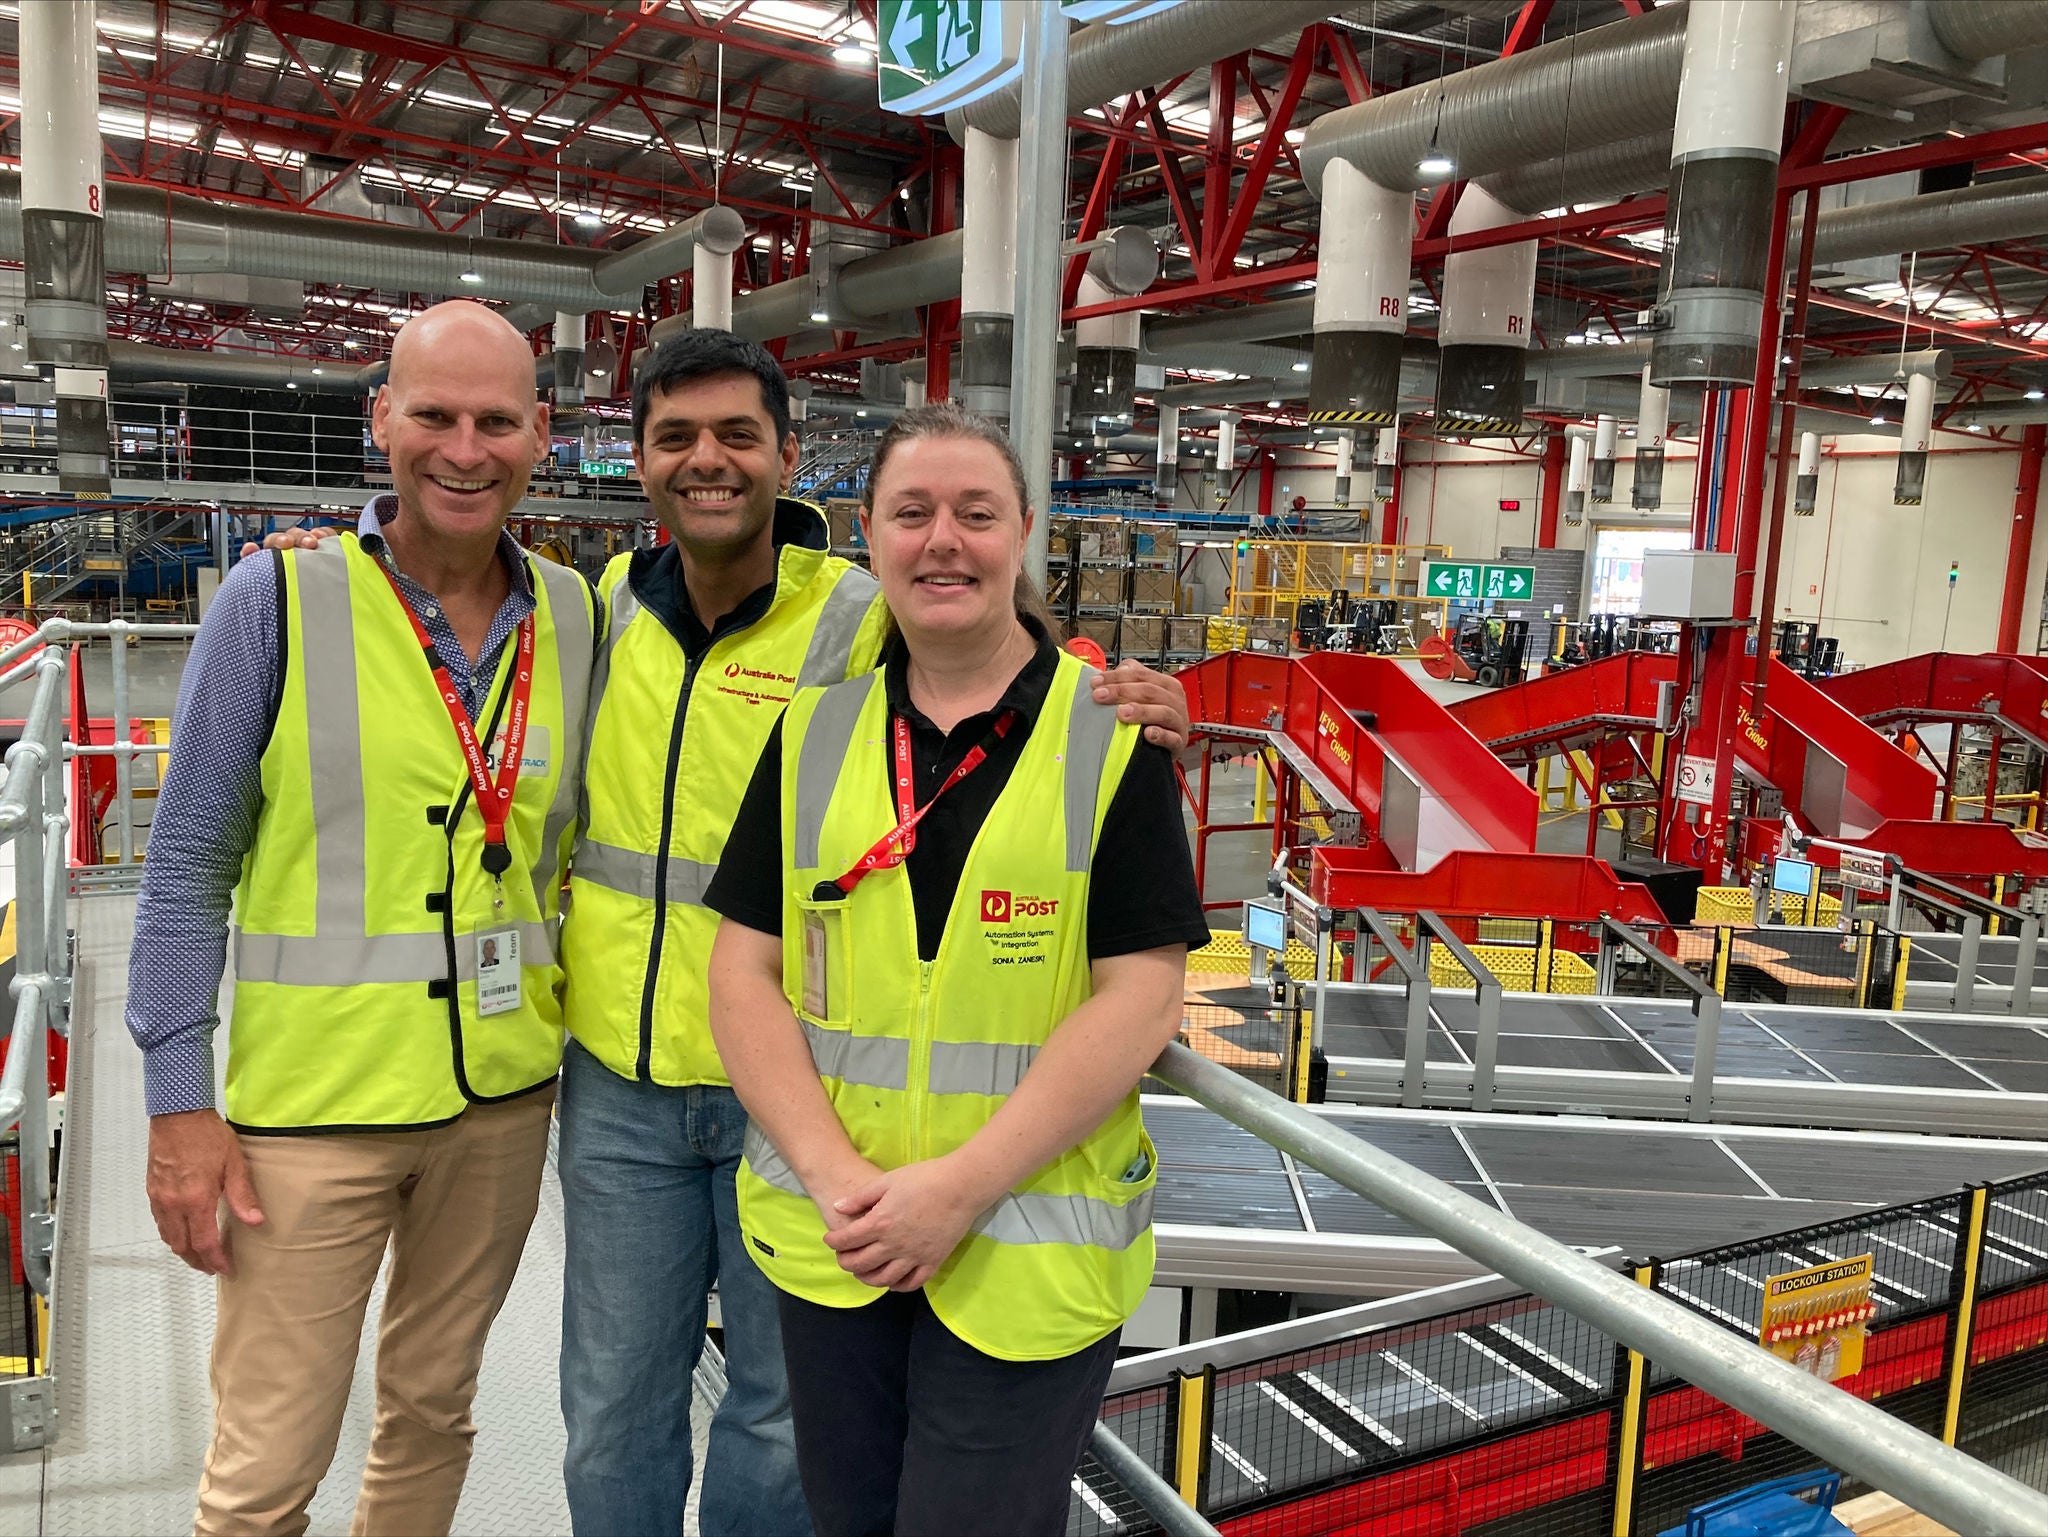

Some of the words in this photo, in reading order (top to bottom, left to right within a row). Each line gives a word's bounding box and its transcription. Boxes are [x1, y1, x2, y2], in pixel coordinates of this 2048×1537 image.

[89, 184, 99, 212] 8
[1380, 297, 1399, 317] R8
[1507, 315, 1523, 334] R1
[99, 378, 104, 395] 7
[523, 631, 531, 654] Post
[741, 668, 776, 680] Australia
[777, 673, 796, 683] Post
[717, 686, 754, 698] Infrastructure
[511, 699, 525, 744] Australia
[1319, 710, 1340, 738] IF102
[458, 721, 473, 745] Post
[1745, 727, 1768, 750] CH002
[505, 746, 518, 770] Post
[898, 740, 907, 761] POST
[1330, 738, 1351, 765] CH002
[468, 745, 488, 791] Australia
[1015, 900, 1059, 916] POST
[1001, 940, 1039, 949] Integration
[1027, 930, 1054, 938] Systems
[992, 957, 1015, 965] SONIA
[1780, 1272, 1825, 1292] LOCKOUT
[1827, 1262, 1865, 1281] STATION
